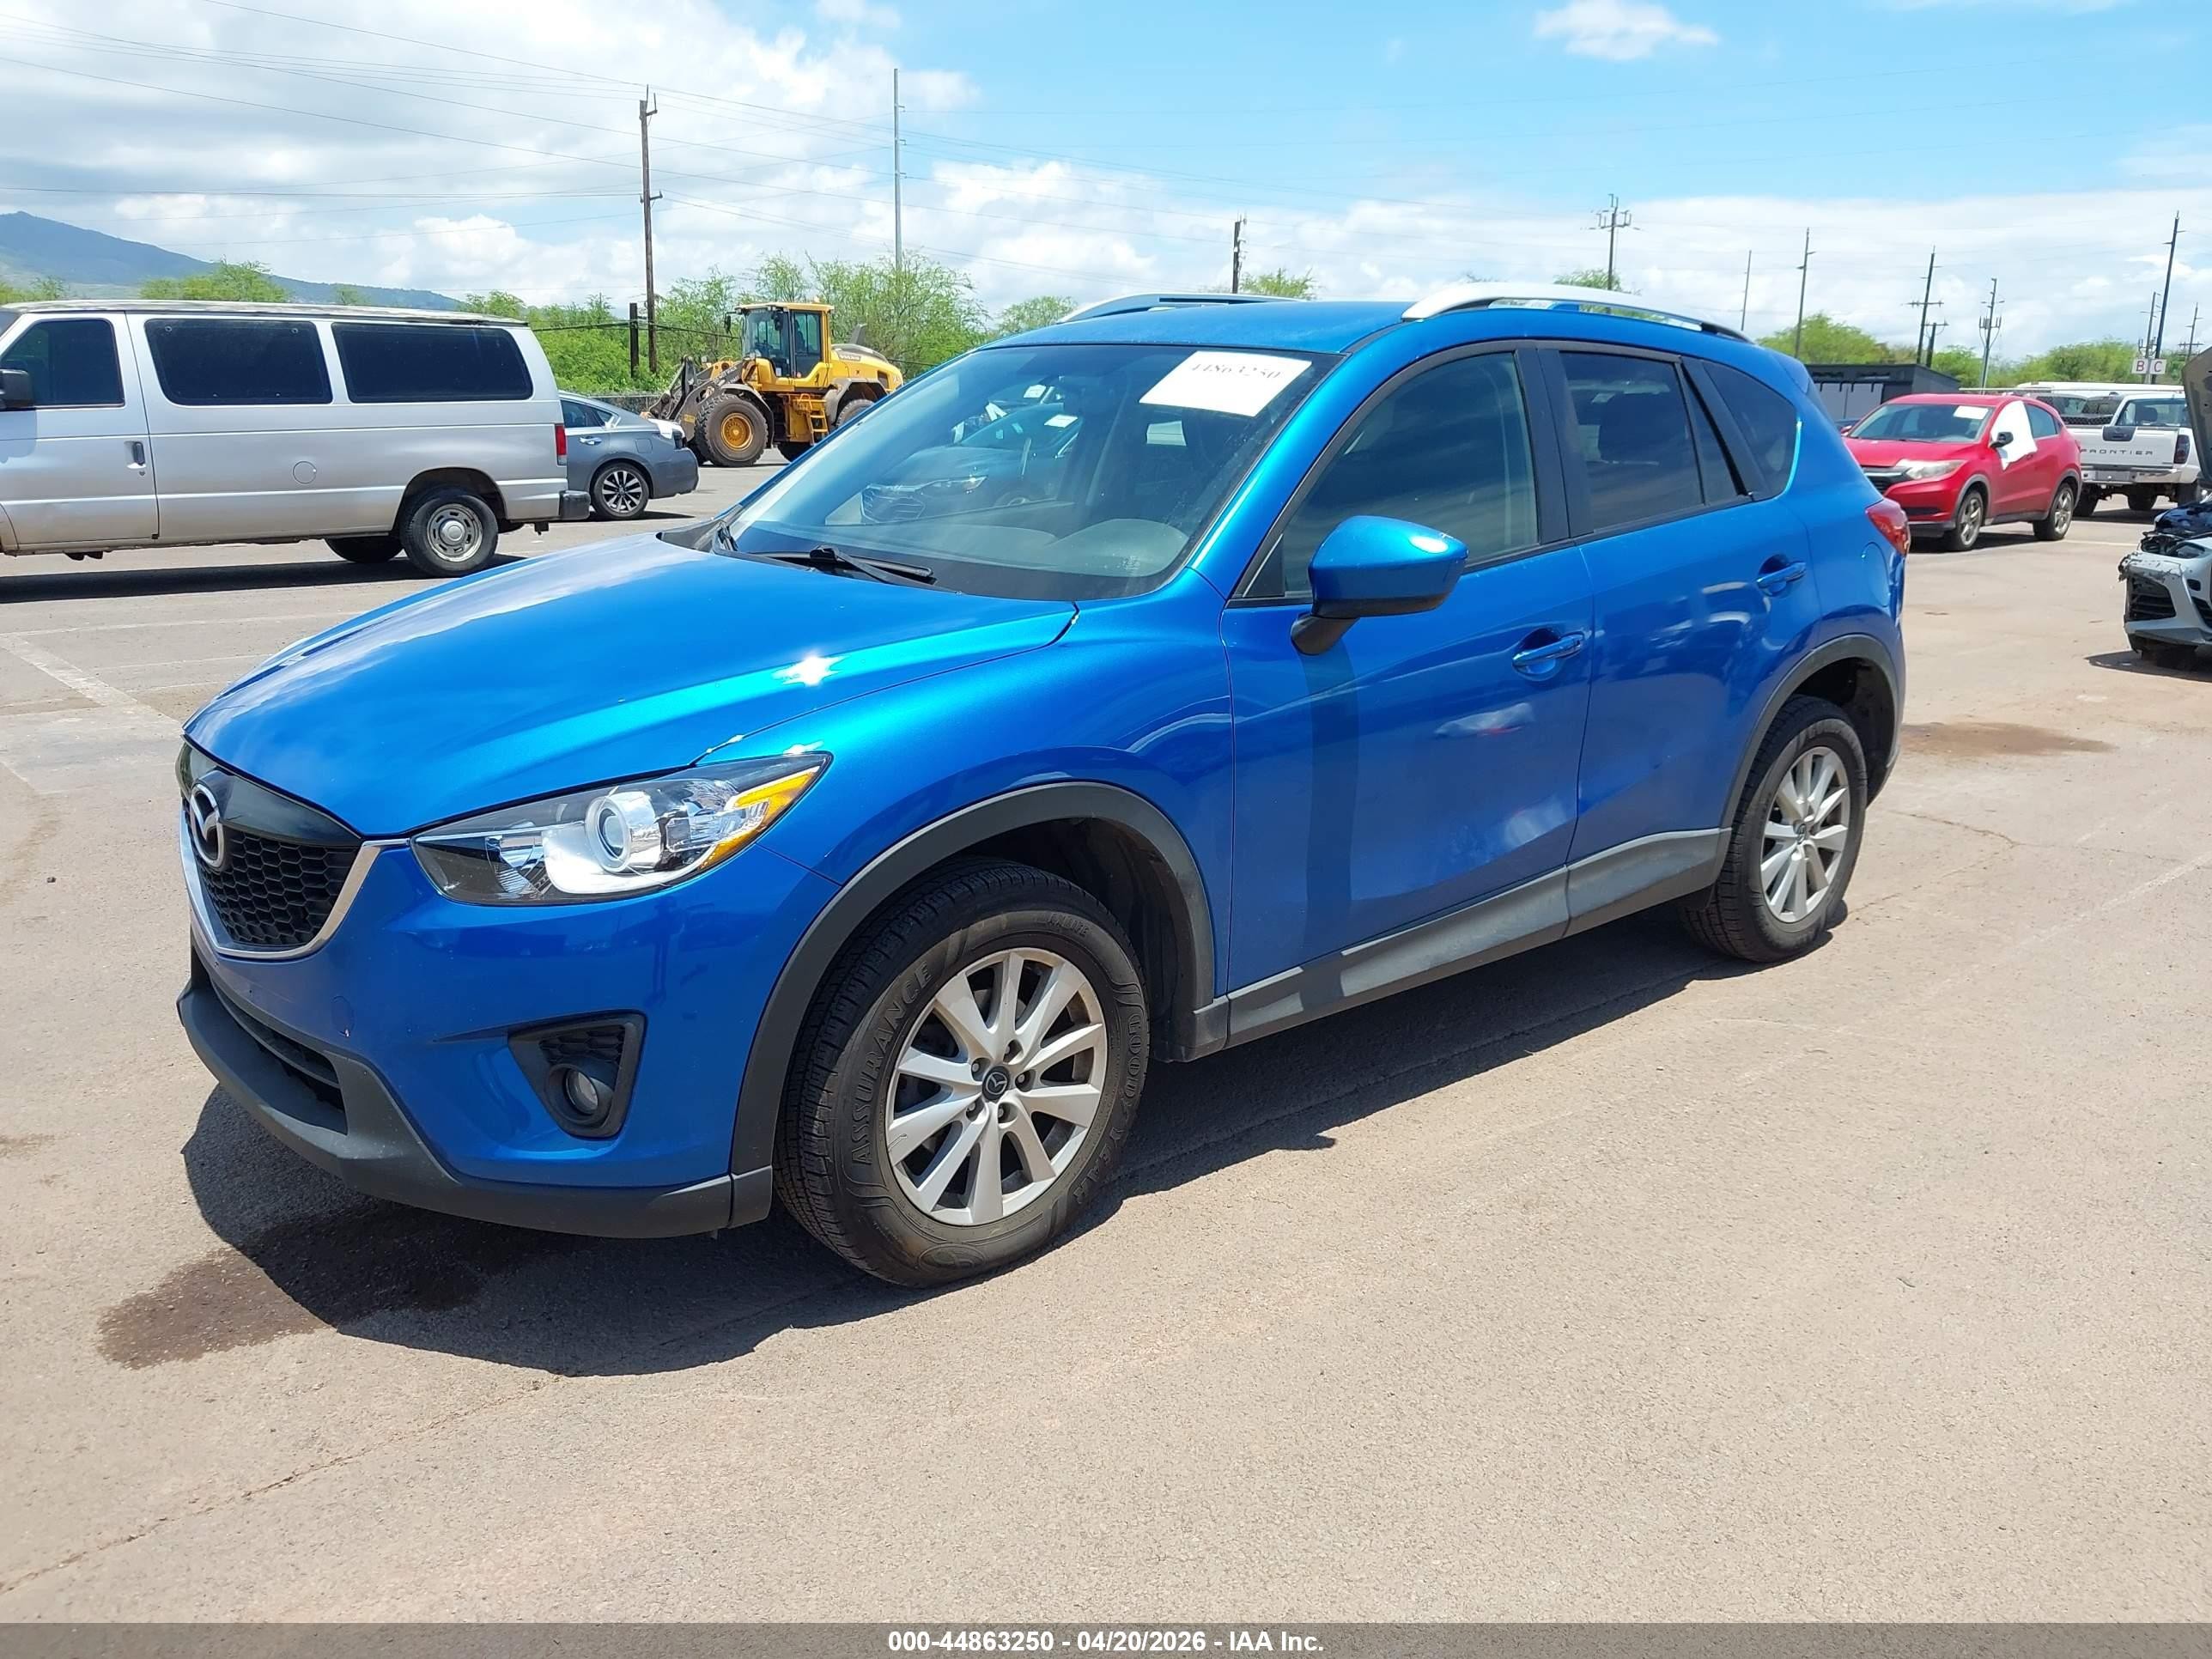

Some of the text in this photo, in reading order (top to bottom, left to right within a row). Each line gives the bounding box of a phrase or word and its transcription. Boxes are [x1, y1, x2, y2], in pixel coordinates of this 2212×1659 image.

[2136, 360, 2145, 372] B
[2154, 361, 2163, 373] C
[851, 960, 933, 1165] ASSURANCE
